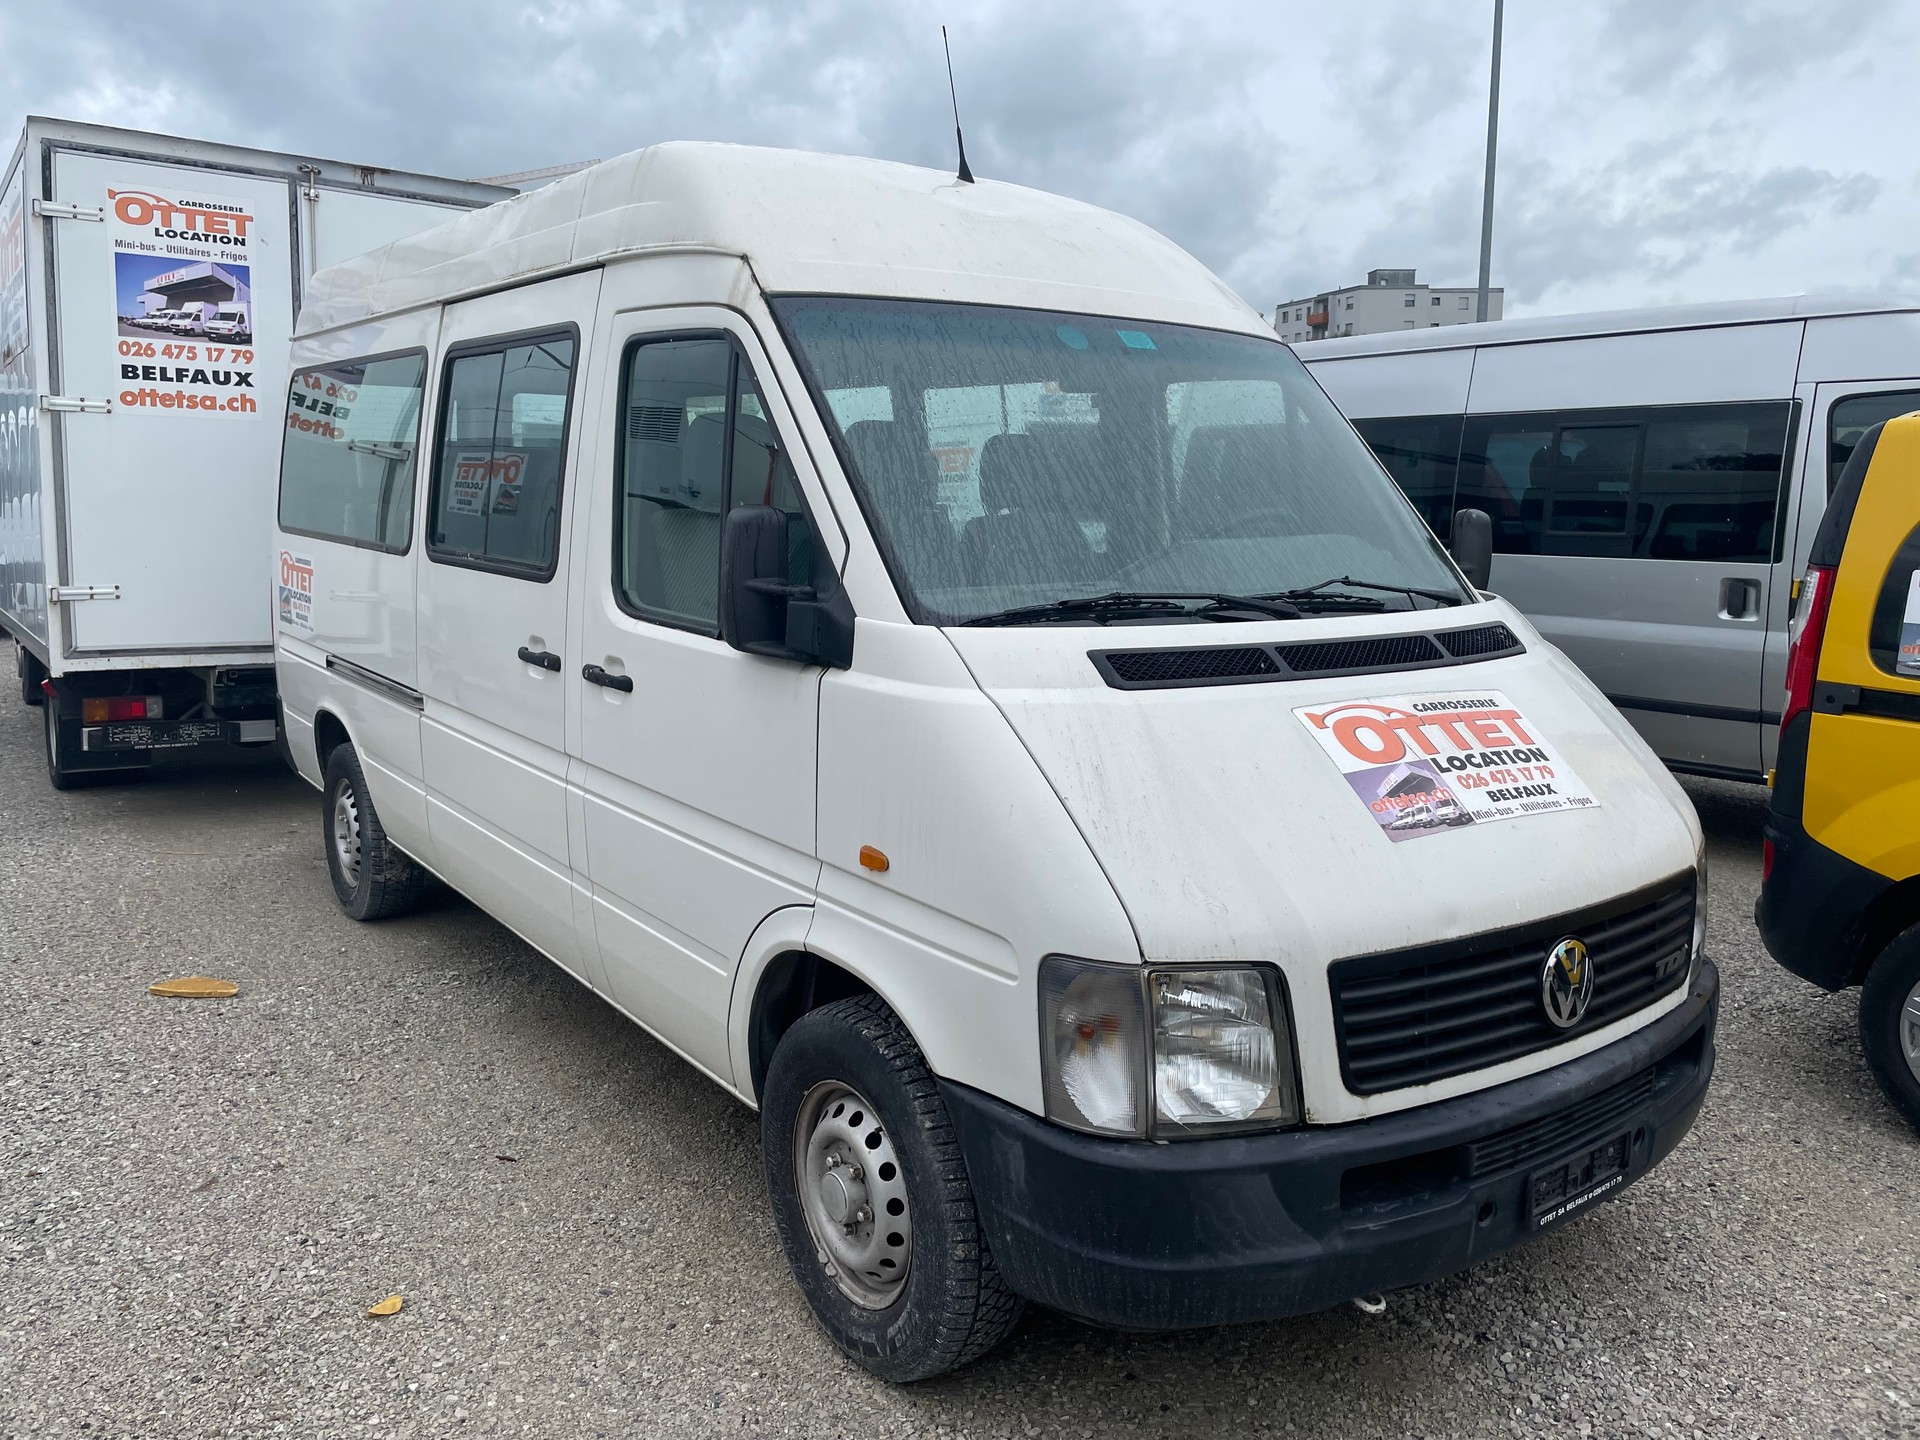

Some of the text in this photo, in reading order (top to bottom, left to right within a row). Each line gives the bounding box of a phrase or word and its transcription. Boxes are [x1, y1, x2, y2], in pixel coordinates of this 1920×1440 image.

[114, 195, 254, 238] OTTET
[178, 199, 244, 213] CARROSSERIE
[154, 227, 246, 247] LOCATION
[114, 239, 157, 252] Mini-bus
[166, 244, 211, 258] Utilitaires
[220, 250, 248, 262] Frigos
[118, 340, 255, 365] 026 475 17 79
[121, 364, 254, 388] BELFAUX
[119, 388, 257, 413] ottetsa.ch
[1412, 698, 1499, 713] CARROSSERIE
[1332, 709, 1536, 765] OTTET
[1429, 747, 1550, 774] LOCATION
[1456, 765, 1555, 790] 026 475 17 79
[1371, 785, 1453, 814] ottetsa.ch
[1485, 783, 1558, 803] BELFAUX
[1471, 806, 1515, 821] Mini-bus
[1519, 799, 1562, 812] Utilitaires
[1566, 796, 1593, 807] Frigos
[1540, 1211, 1557, 1226] OTTET
[1557, 1207, 1565, 1216] SA
[1566, 1193, 1588, 1211] BELFAUX
